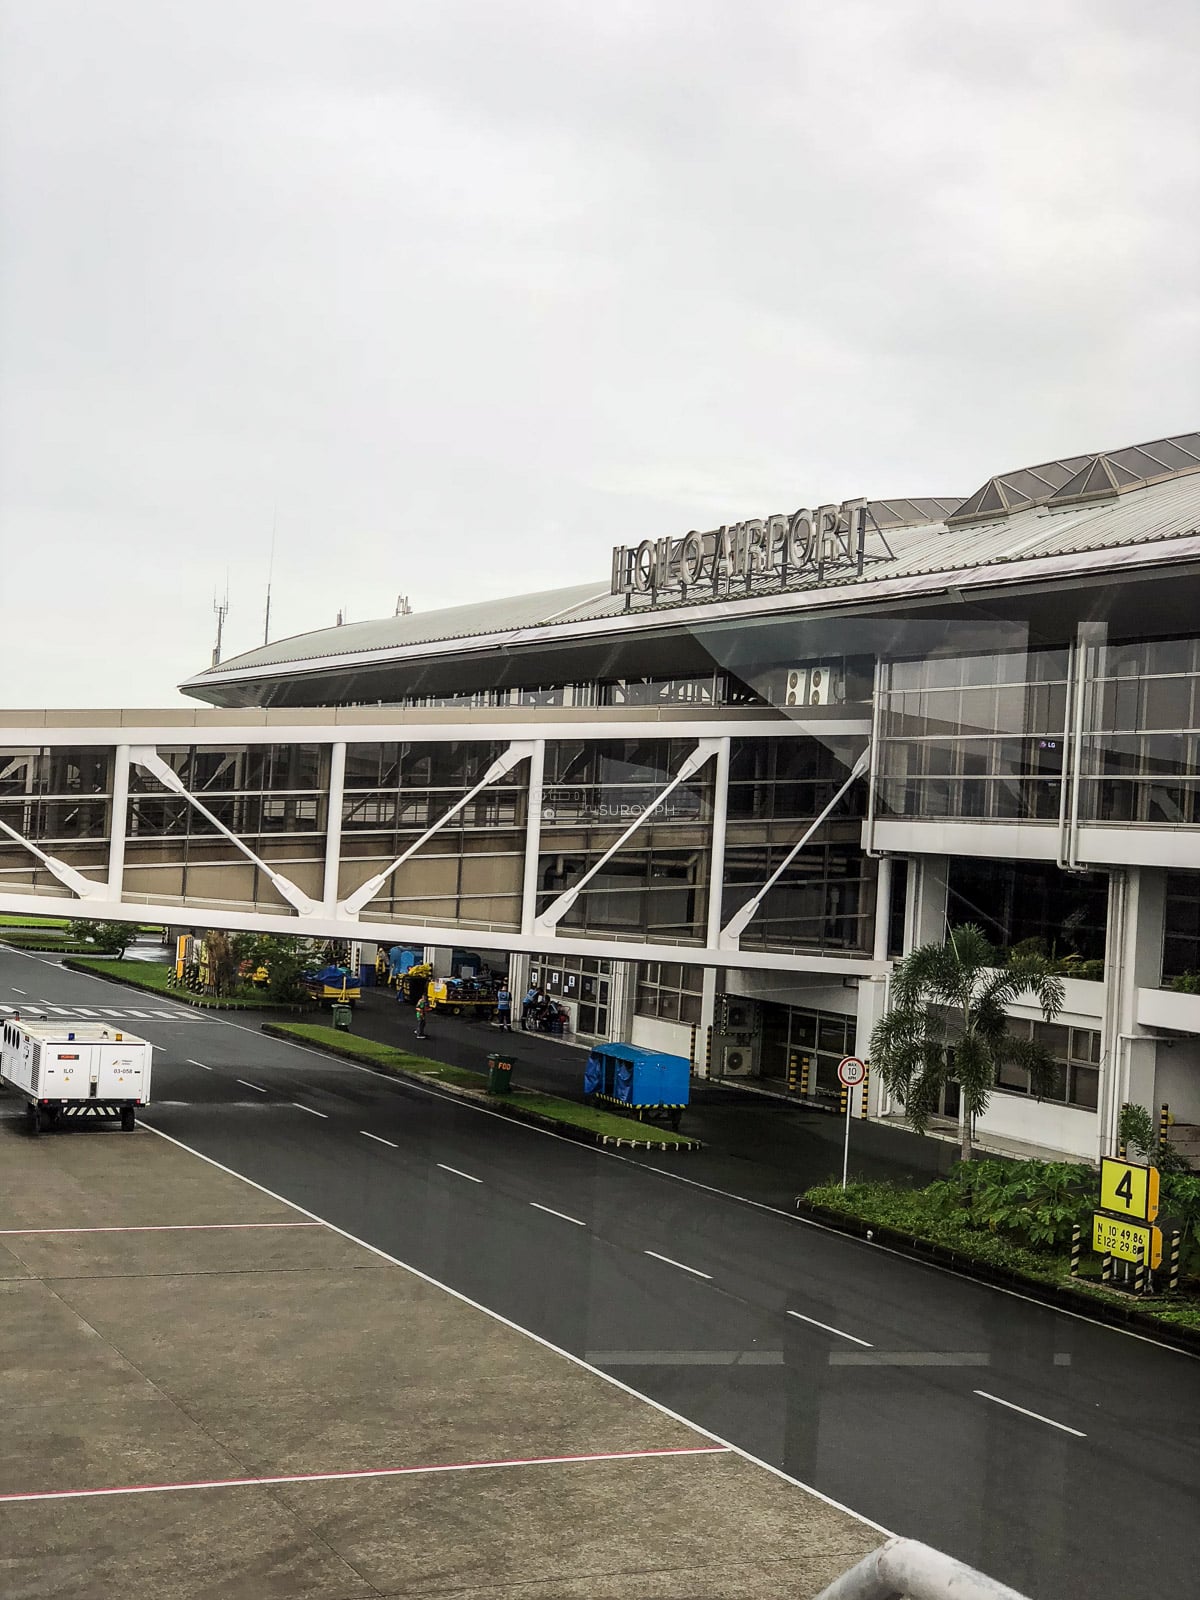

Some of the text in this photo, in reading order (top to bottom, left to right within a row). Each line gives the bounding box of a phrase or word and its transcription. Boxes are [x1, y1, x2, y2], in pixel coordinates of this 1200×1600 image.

[611, 497, 867, 595] ILOILO AIRPORT
[848, 1067, 857, 1076] 10
[1115, 1170, 1133, 1209] 4
[1097, 1222, 1103, 1233] N
[1097, 1234, 1102, 1245] E
[1119, 1241, 1139, 1255] 29.8
